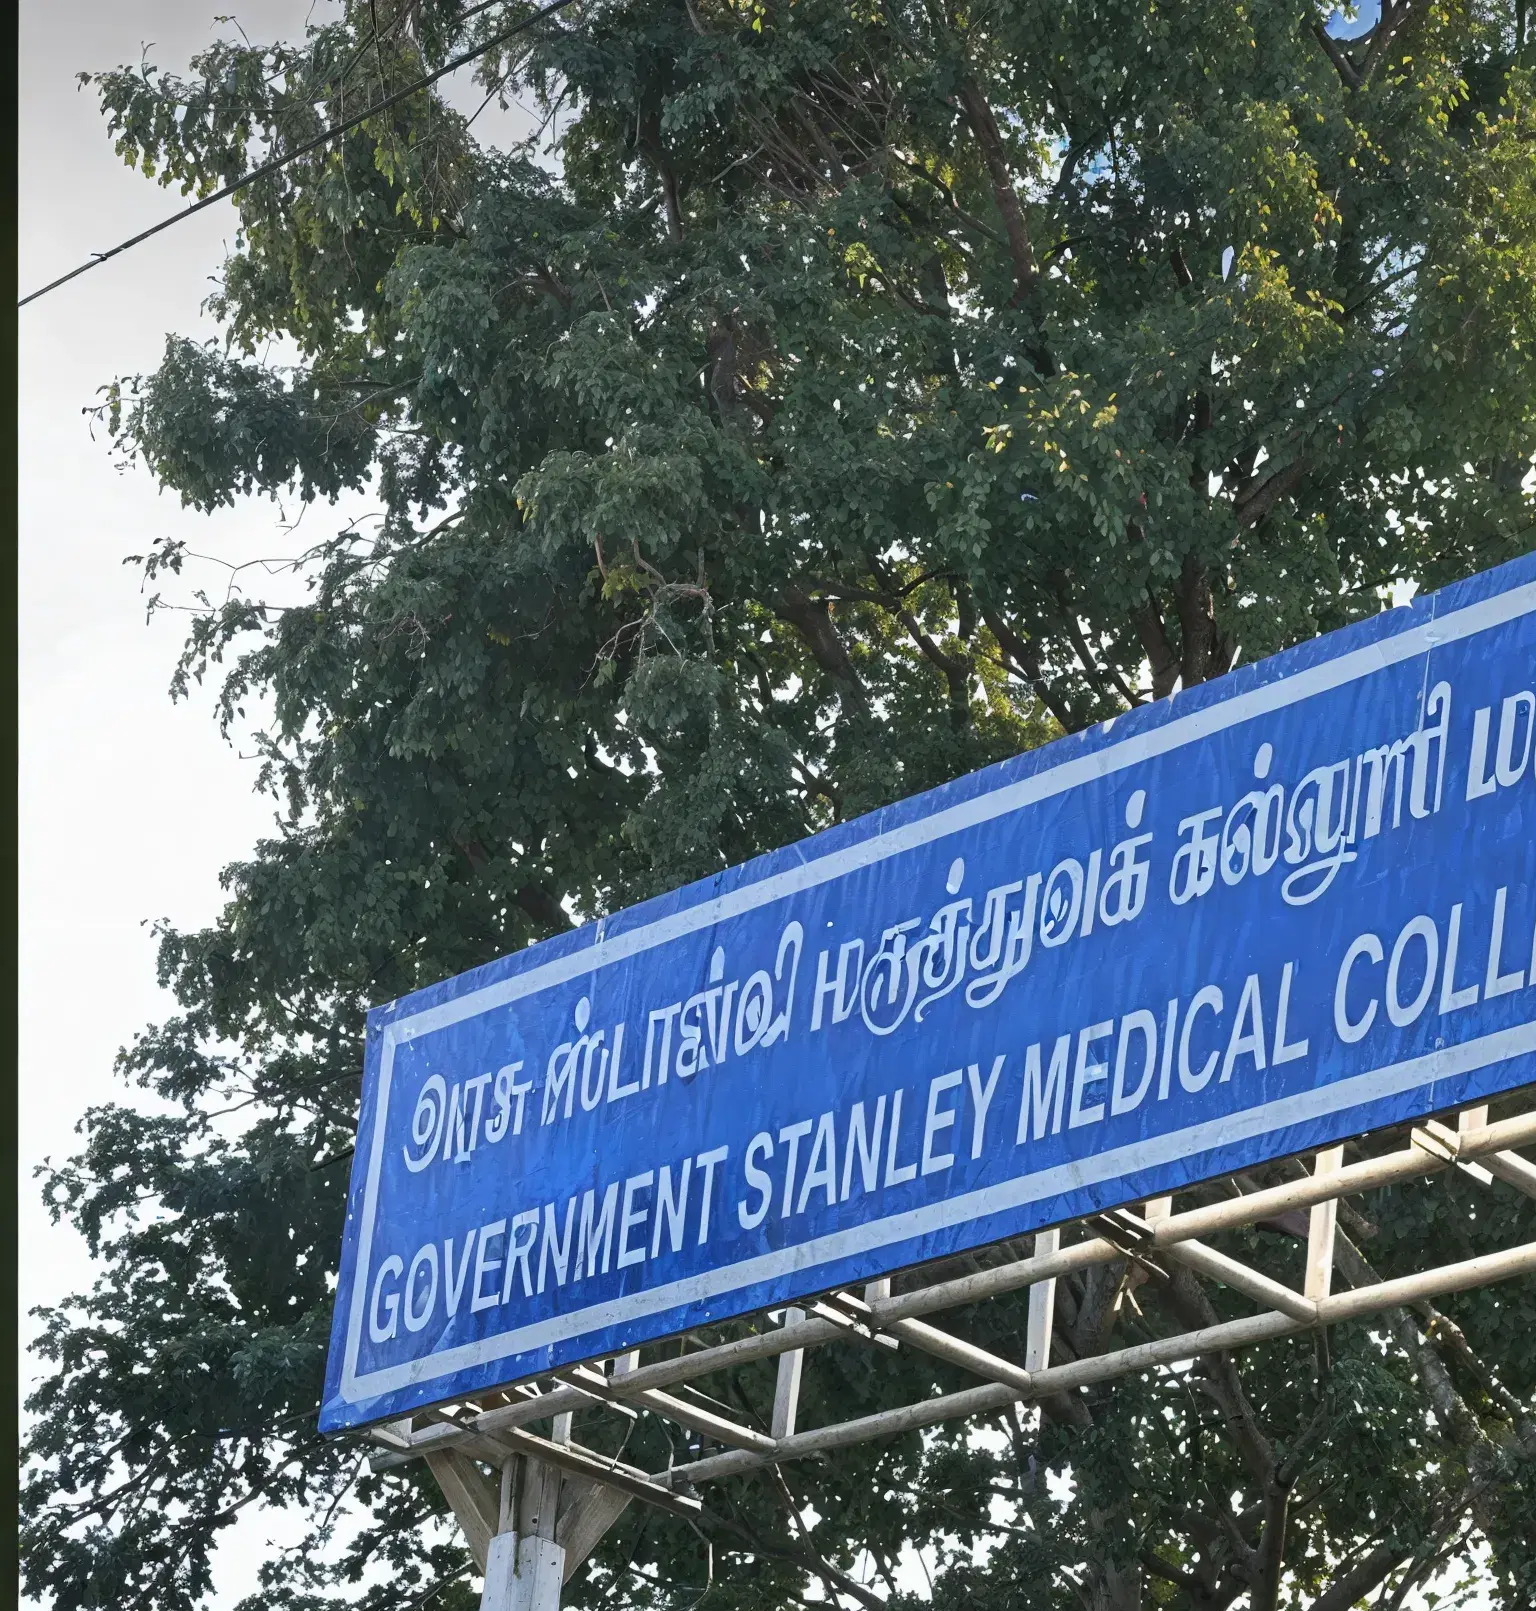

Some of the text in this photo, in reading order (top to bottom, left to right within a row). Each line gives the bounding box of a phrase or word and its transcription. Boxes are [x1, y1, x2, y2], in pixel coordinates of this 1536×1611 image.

[367, 1145, 729, 1344] GOVERNMENT
[737, 1054, 1006, 1231] STANLEY
[1016, 961, 1310, 1145] MEDICAL
